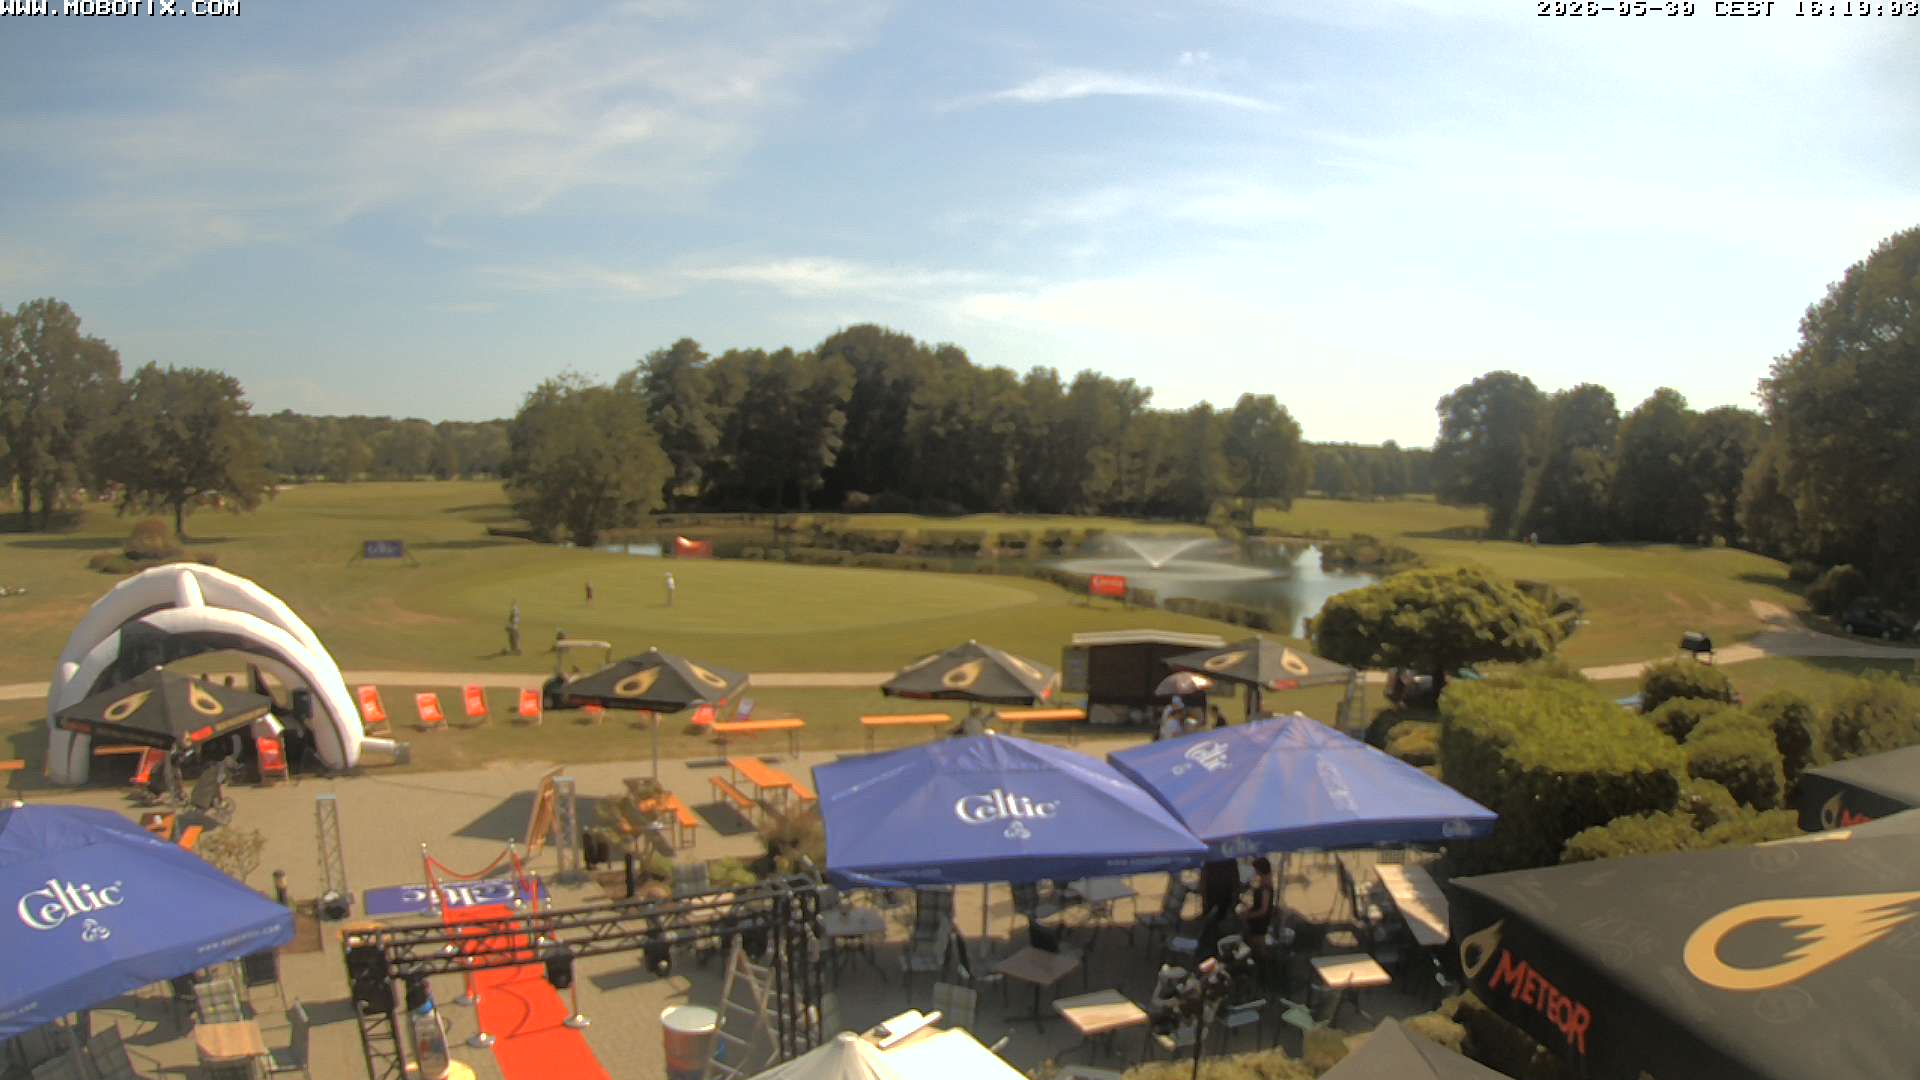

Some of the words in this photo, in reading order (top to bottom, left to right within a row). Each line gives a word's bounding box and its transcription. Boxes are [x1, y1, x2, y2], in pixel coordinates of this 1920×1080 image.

[955, 788, 1059, 824] Celtic
[17, 878, 124, 931] Celtic
[1487, 948, 1593, 1056] METEOR
